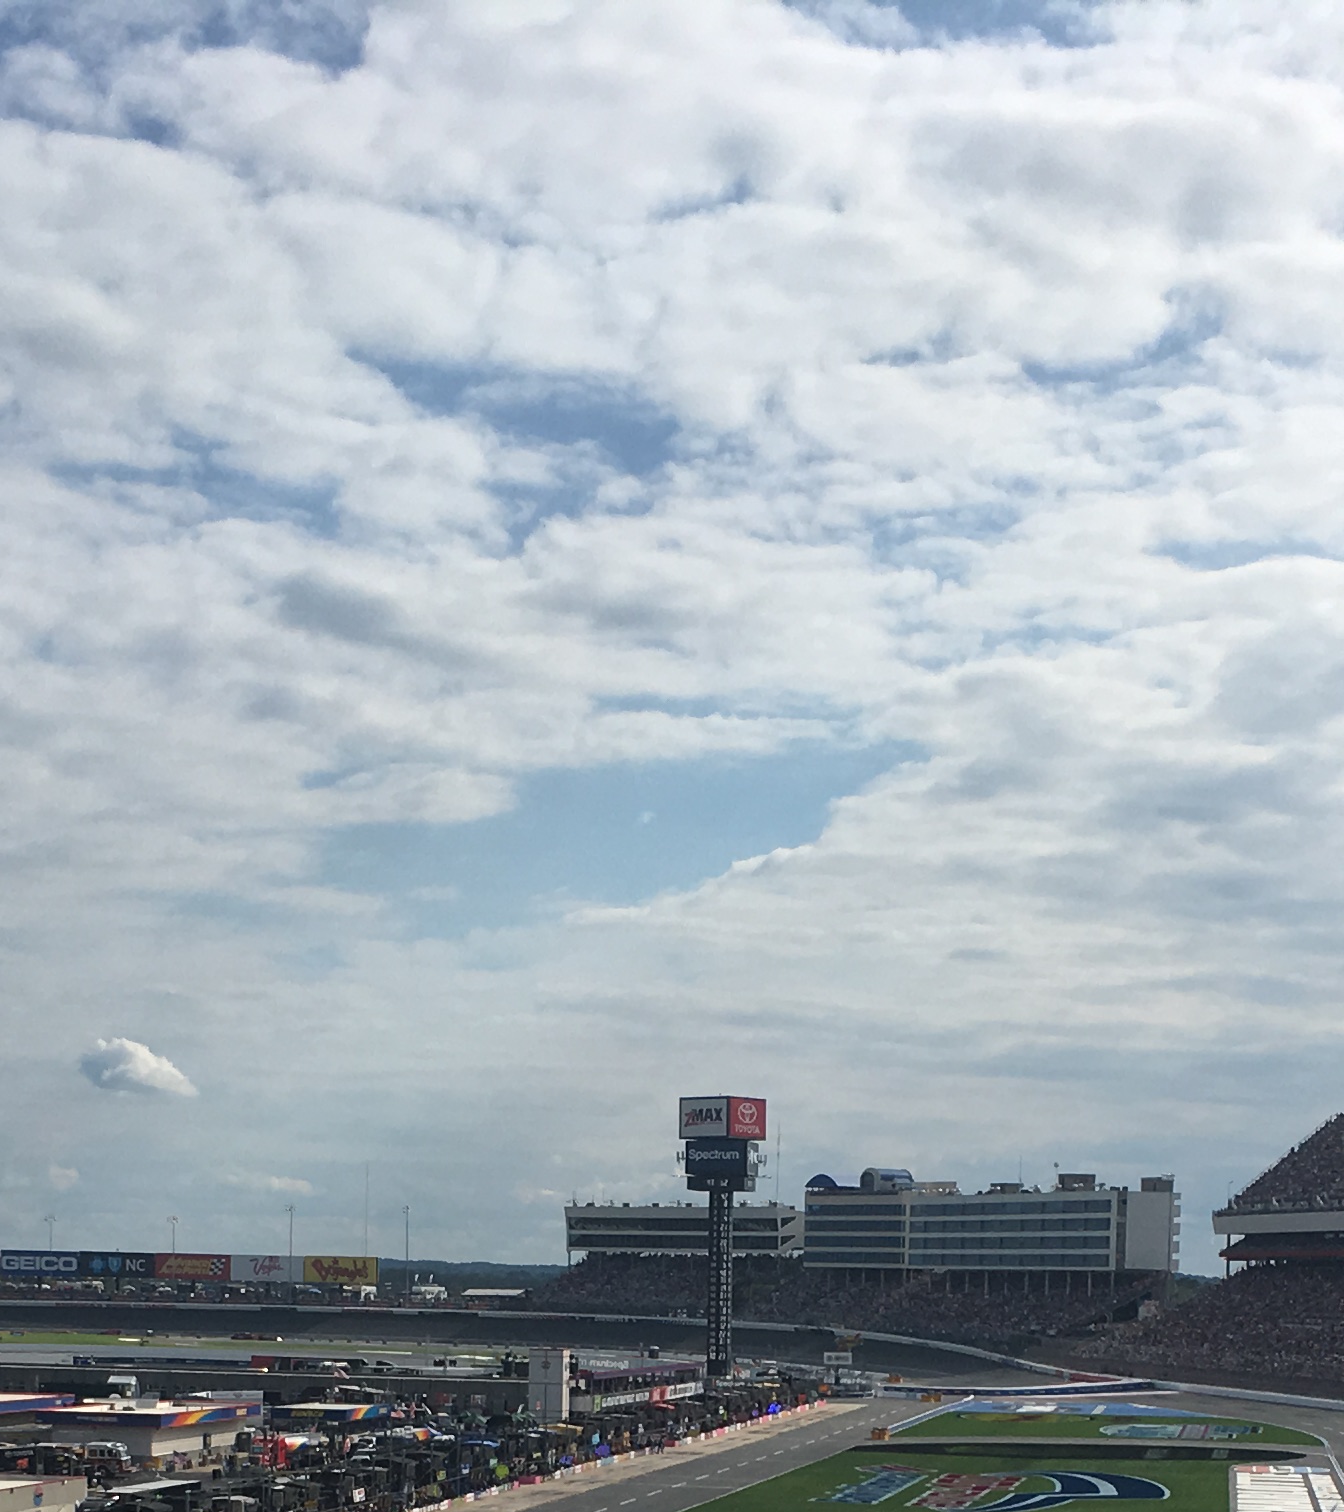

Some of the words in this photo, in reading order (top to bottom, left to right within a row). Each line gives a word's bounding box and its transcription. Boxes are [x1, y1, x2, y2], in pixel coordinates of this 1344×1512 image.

[735, 1124, 761, 1134] TOYOTA
[688, 1149, 740, 1161] Spectrum
[1, 1256, 78, 1272] GEICO
[125, 1260, 146, 1272] NC
